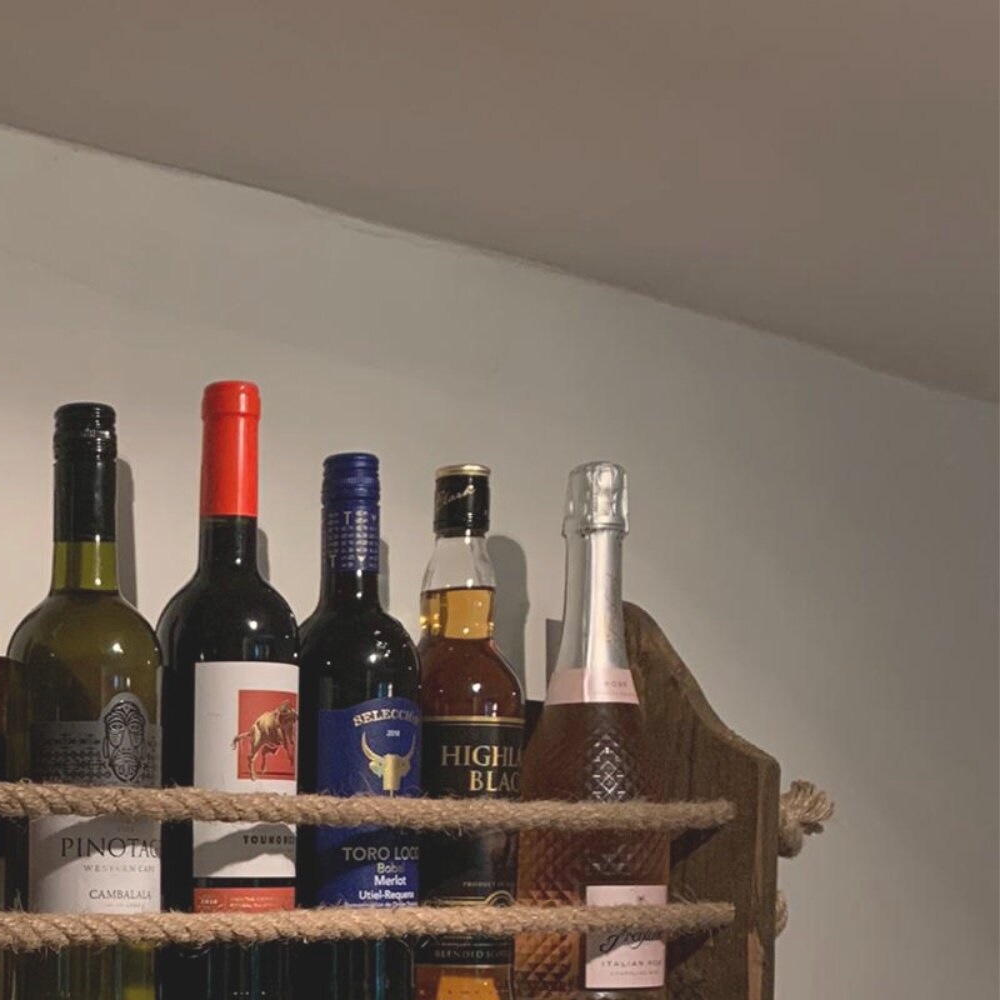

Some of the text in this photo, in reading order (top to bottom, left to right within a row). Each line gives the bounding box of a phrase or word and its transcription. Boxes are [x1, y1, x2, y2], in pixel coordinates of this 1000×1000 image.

[341, 846, 390, 861] TORO
[374, 874, 407, 886] Merlot
[88, 889, 153, 900] CAMBALALA
[601, 960, 645, 968] ITALIAN
